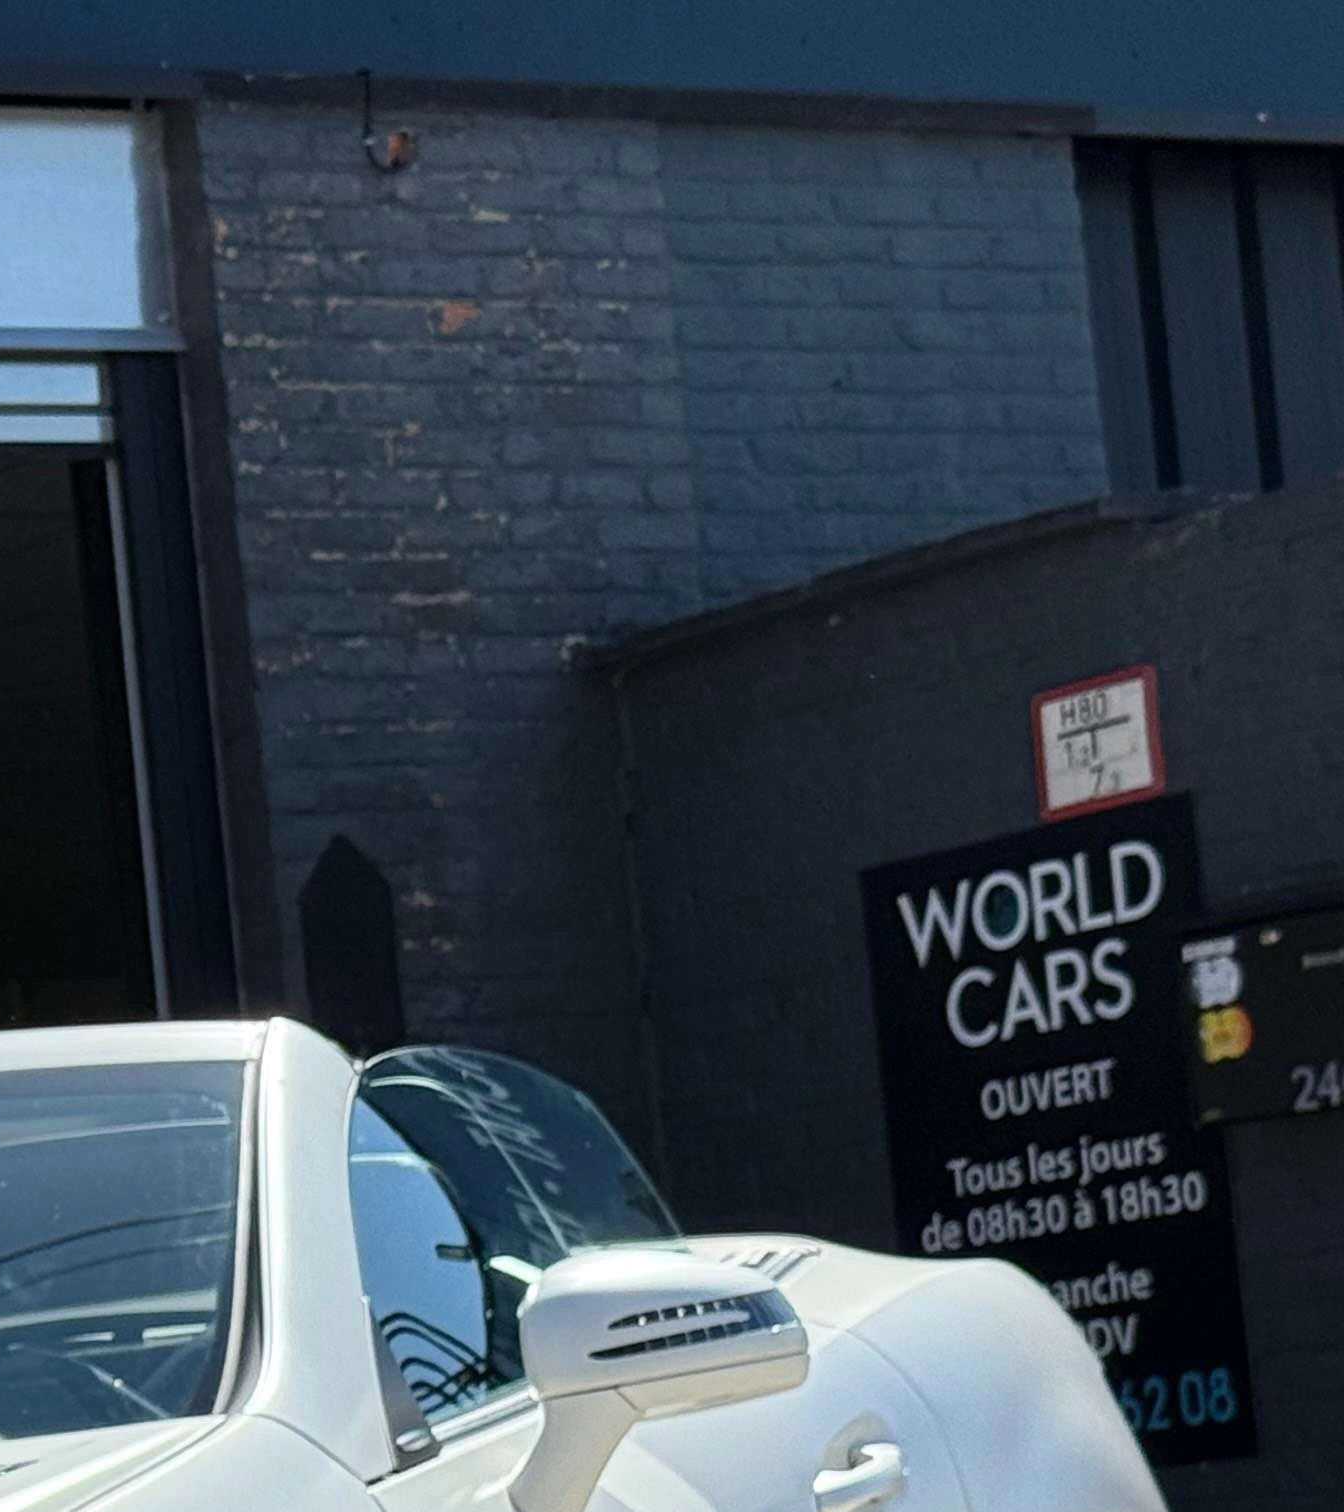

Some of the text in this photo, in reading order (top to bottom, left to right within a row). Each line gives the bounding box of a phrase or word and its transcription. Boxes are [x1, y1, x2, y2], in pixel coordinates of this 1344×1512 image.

[897, 841, 1166, 968] WORLD
[946, 938, 1136, 1048] CARS
[981, 1058, 1117, 1120] OUVERT
[946, 1132, 1167, 1199] Tous les jours
[921, 1171, 1206, 1254] de 08h30 à 18h30
[1179, 1367, 1238, 1427] 08
